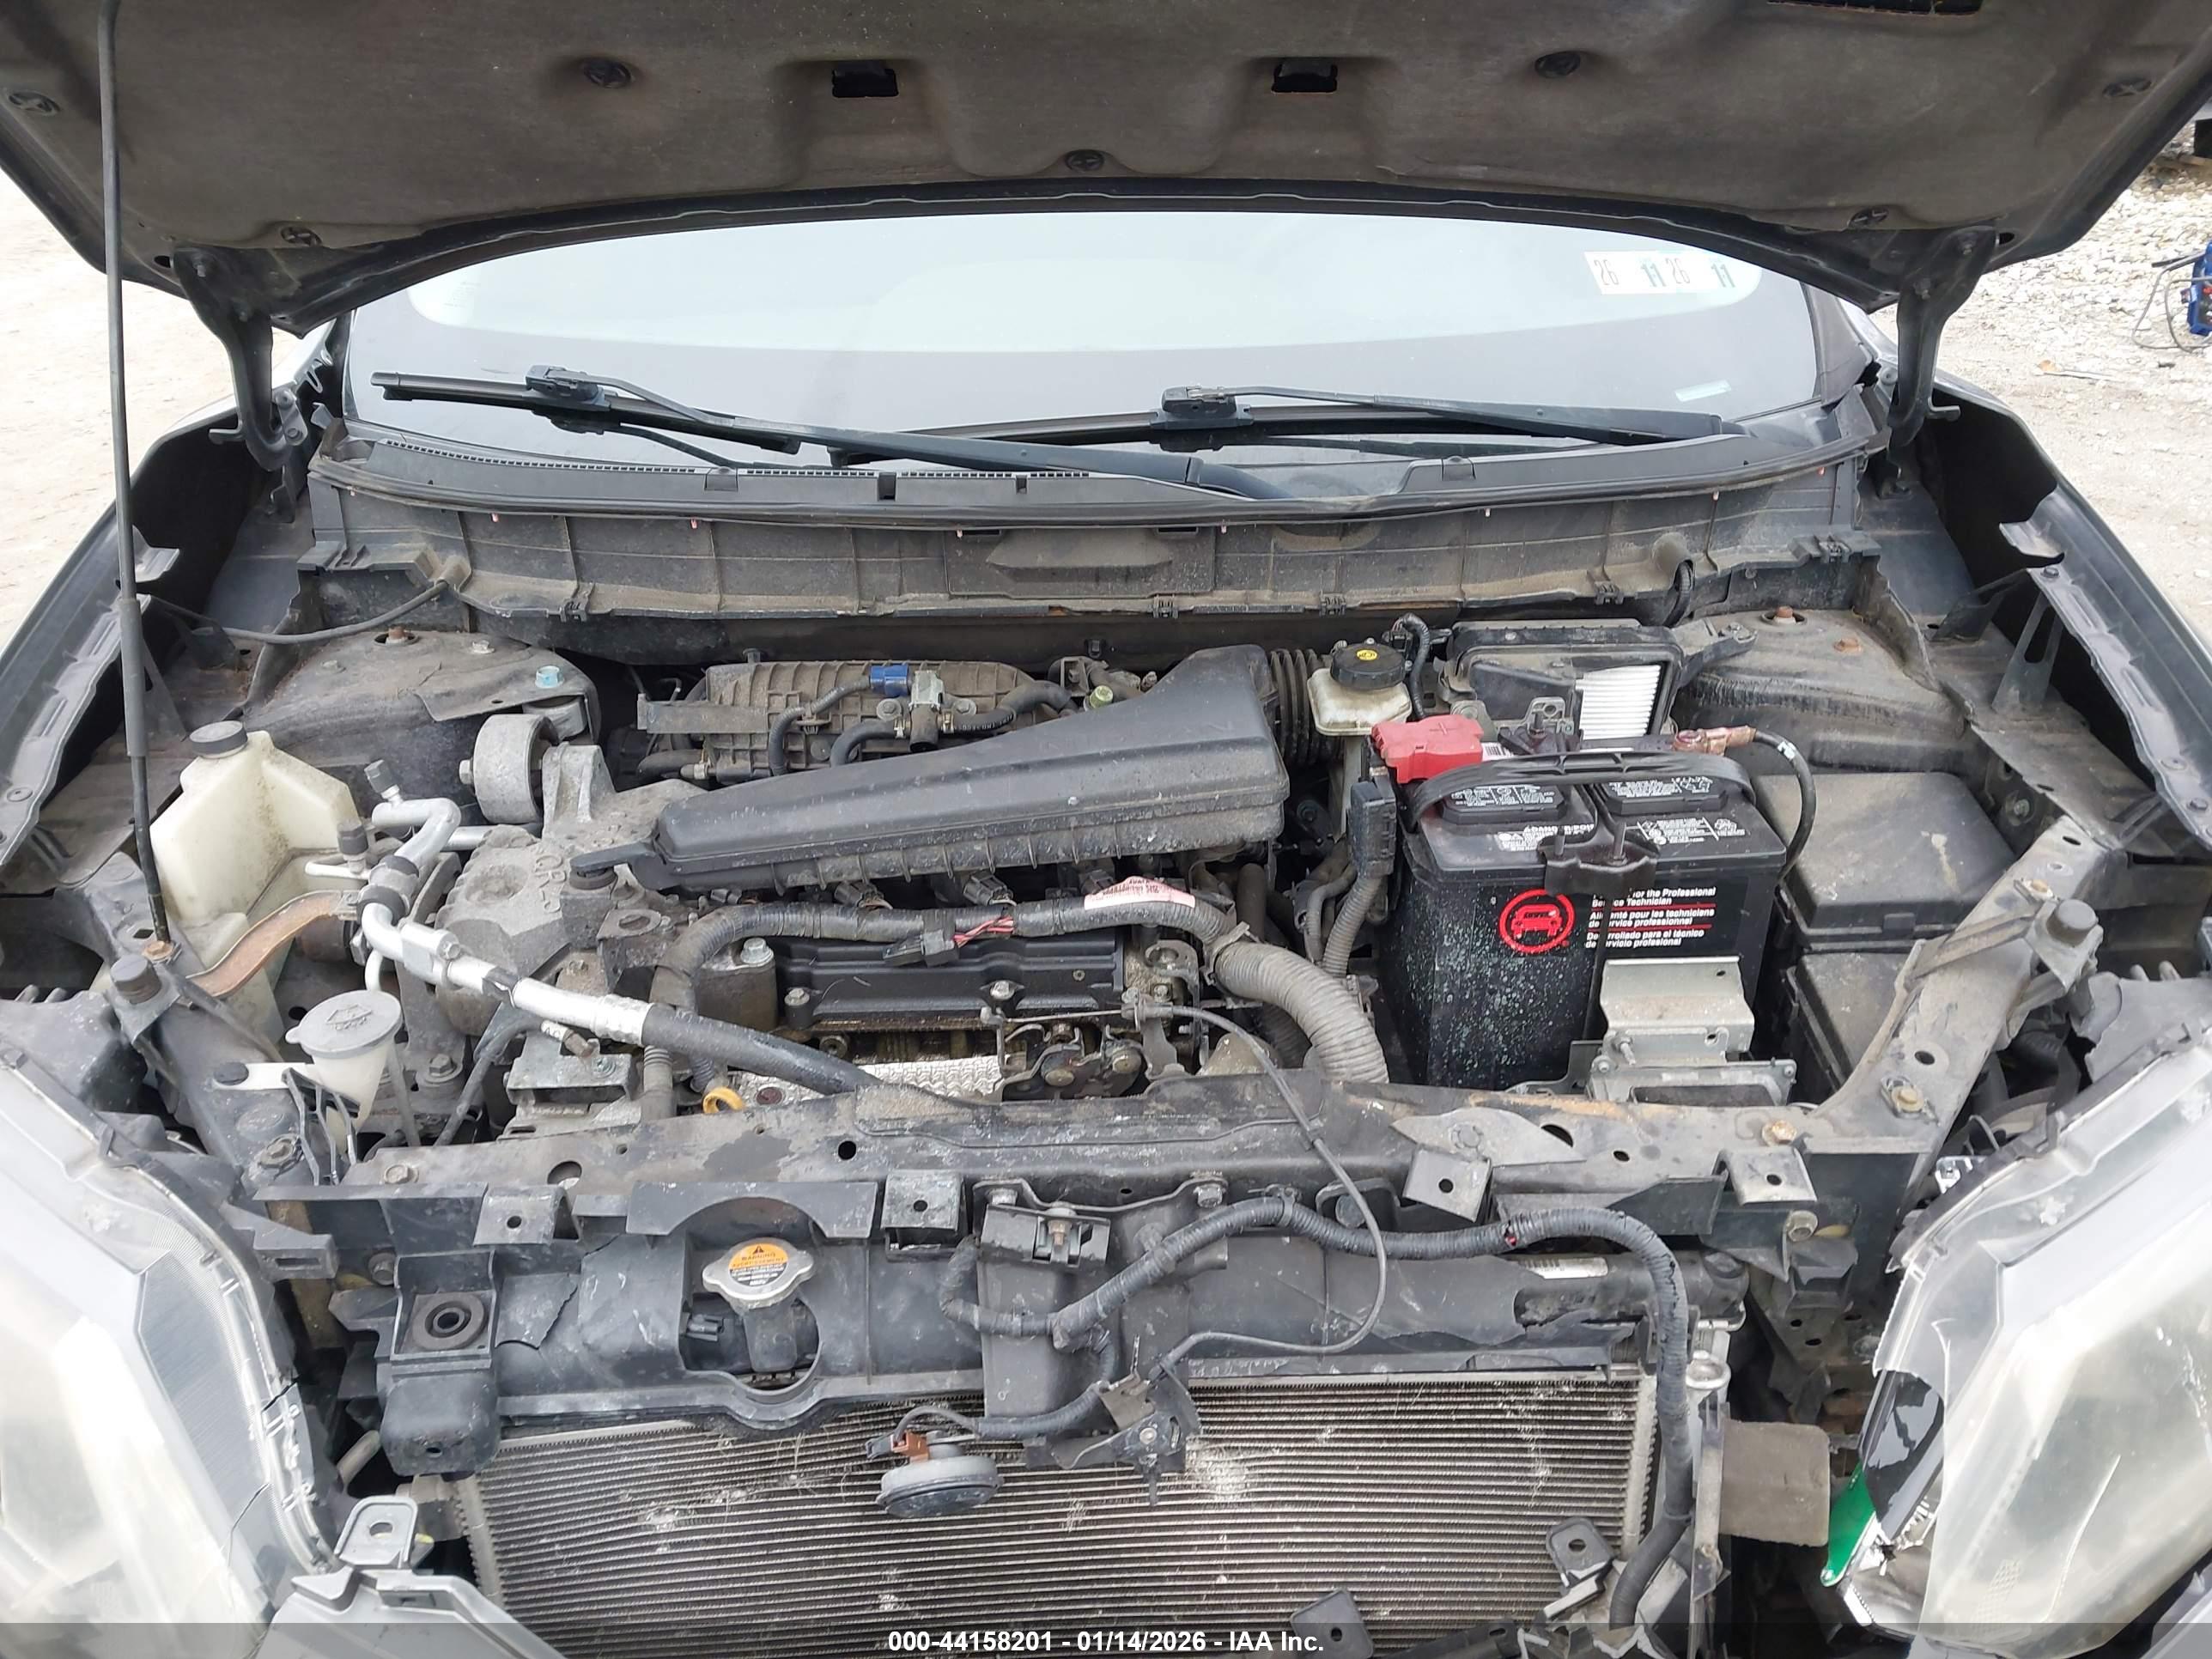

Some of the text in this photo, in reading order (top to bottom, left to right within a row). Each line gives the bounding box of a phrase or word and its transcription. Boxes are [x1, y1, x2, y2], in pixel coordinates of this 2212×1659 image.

[1594, 258, 1620, 285] 26
[1665, 258, 1691, 284] 26
[1646, 889, 1660, 898] the
[1662, 887, 1717, 898] Professional
[1592, 896, 1673, 908] Sece Technician
[1628, 910, 1650, 921] pour
[1651, 908, 1663, 918] les
[1665, 908, 1715, 918] techniciens
[1589, 919, 1600, 928] de
[1633, 916, 1693, 928] professionnel
[1587, 927, 1705, 941] Derrollado para el técnico
[1585, 940, 1597, 949] de
[1633, 938, 1682, 949] profesional
